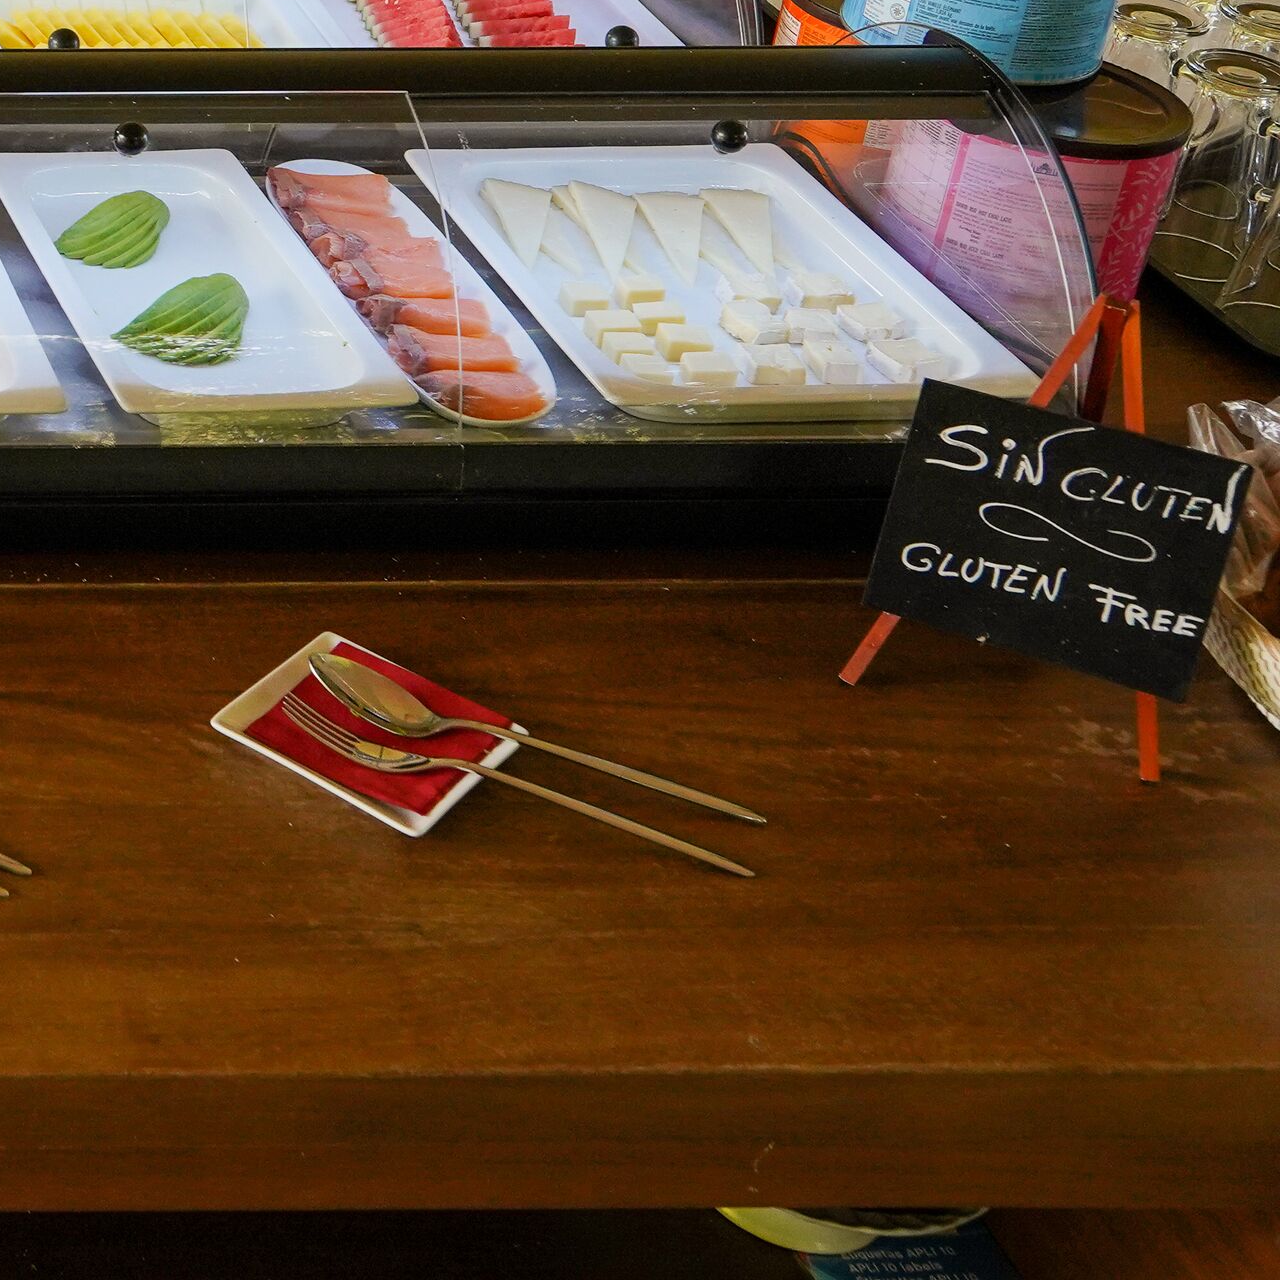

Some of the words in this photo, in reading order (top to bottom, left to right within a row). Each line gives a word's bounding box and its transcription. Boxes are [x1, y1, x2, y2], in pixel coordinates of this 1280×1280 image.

[901, 542, 1067, 602] GLUTEN
[1088, 583, 1207, 638] FREE
[906, 1246, 937, 1258] APLI
[940, 1246, 956, 1257] 10
[849, 1262, 880, 1273] APLI
[881, 1262, 897, 1272] 10
[900, 1260, 942, 1273] labels
